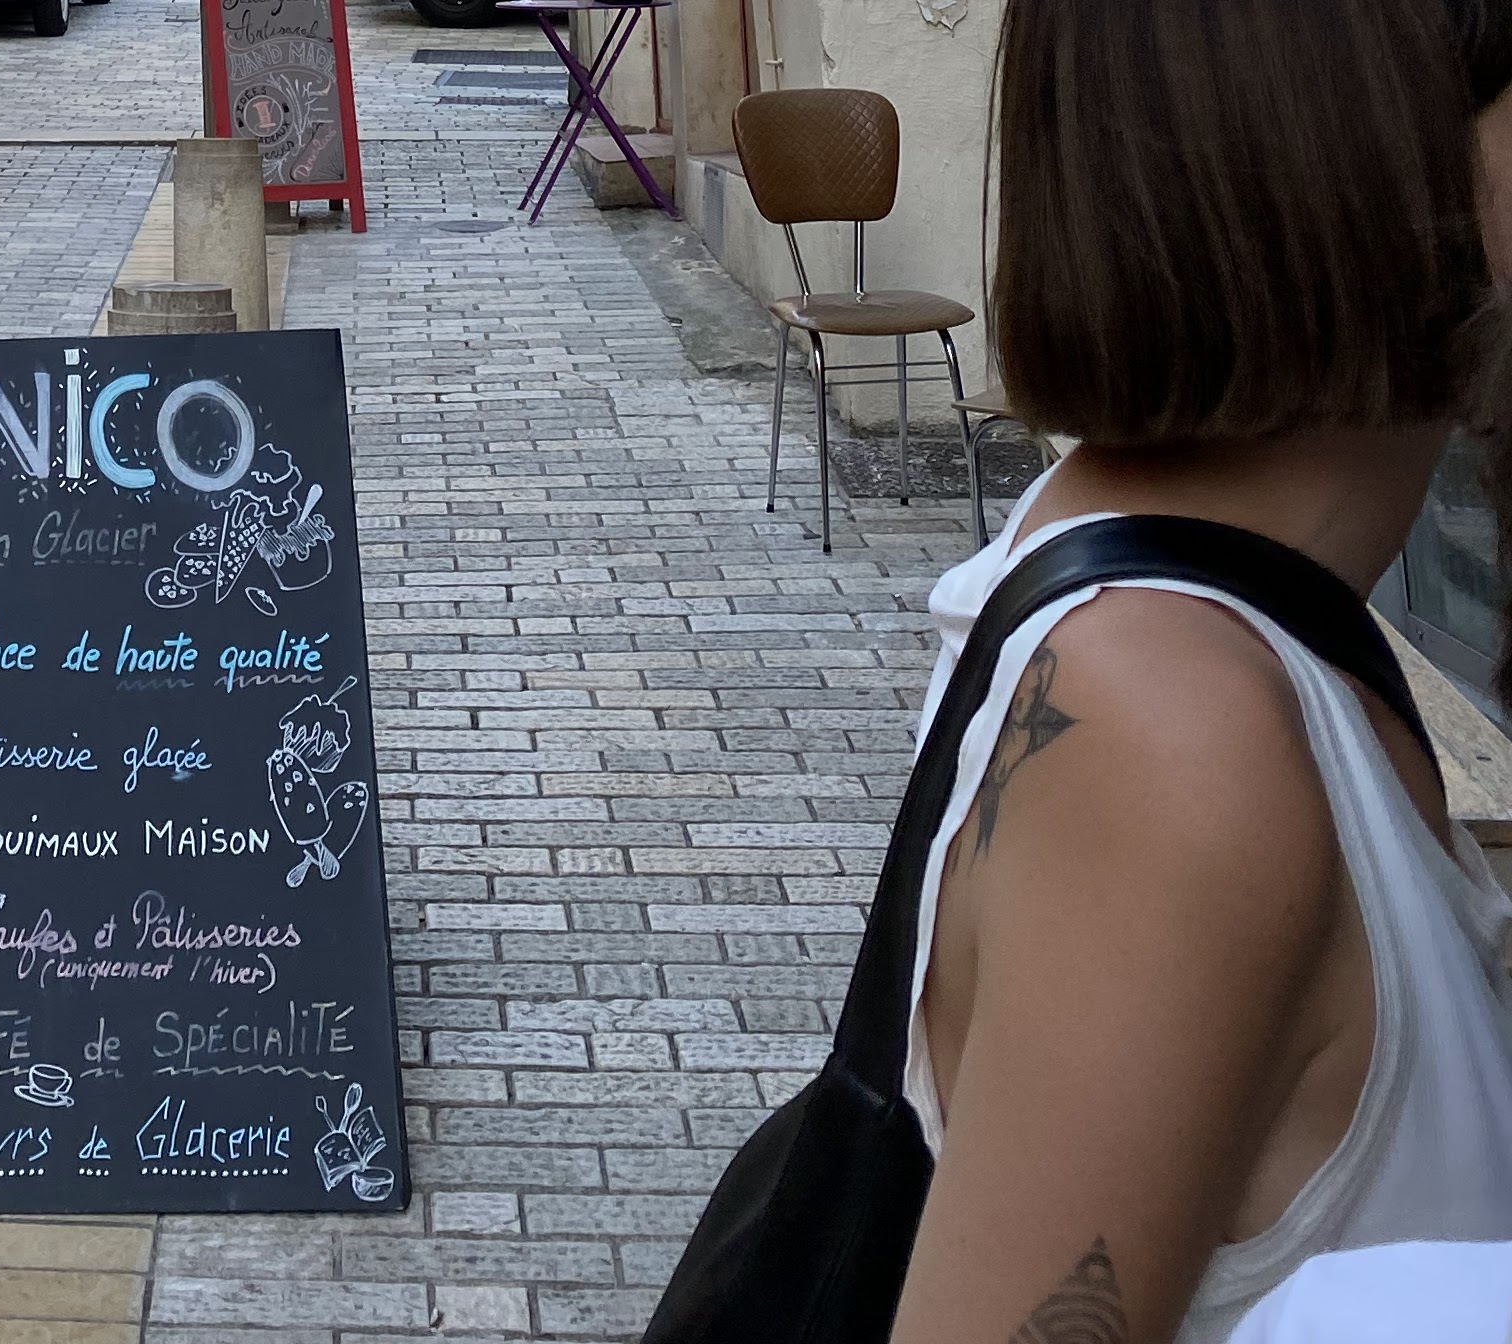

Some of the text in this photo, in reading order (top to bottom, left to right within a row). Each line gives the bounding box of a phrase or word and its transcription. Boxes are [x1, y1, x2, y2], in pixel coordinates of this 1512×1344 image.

[229, 41, 283, 78] HAND
[256, 121, 291, 145] ADEAUX
[32, 509, 158, 560] Glacier
[61, 630, 100, 674] de
[115, 625, 199, 675] haute
[219, 630, 331, 693] qualité
[94, 914, 118, 950] et
[82, 1017, 122, 1062] de
[78, 1125, 112, 1161] de
[136, 1095, 292, 1162] Glacerie
